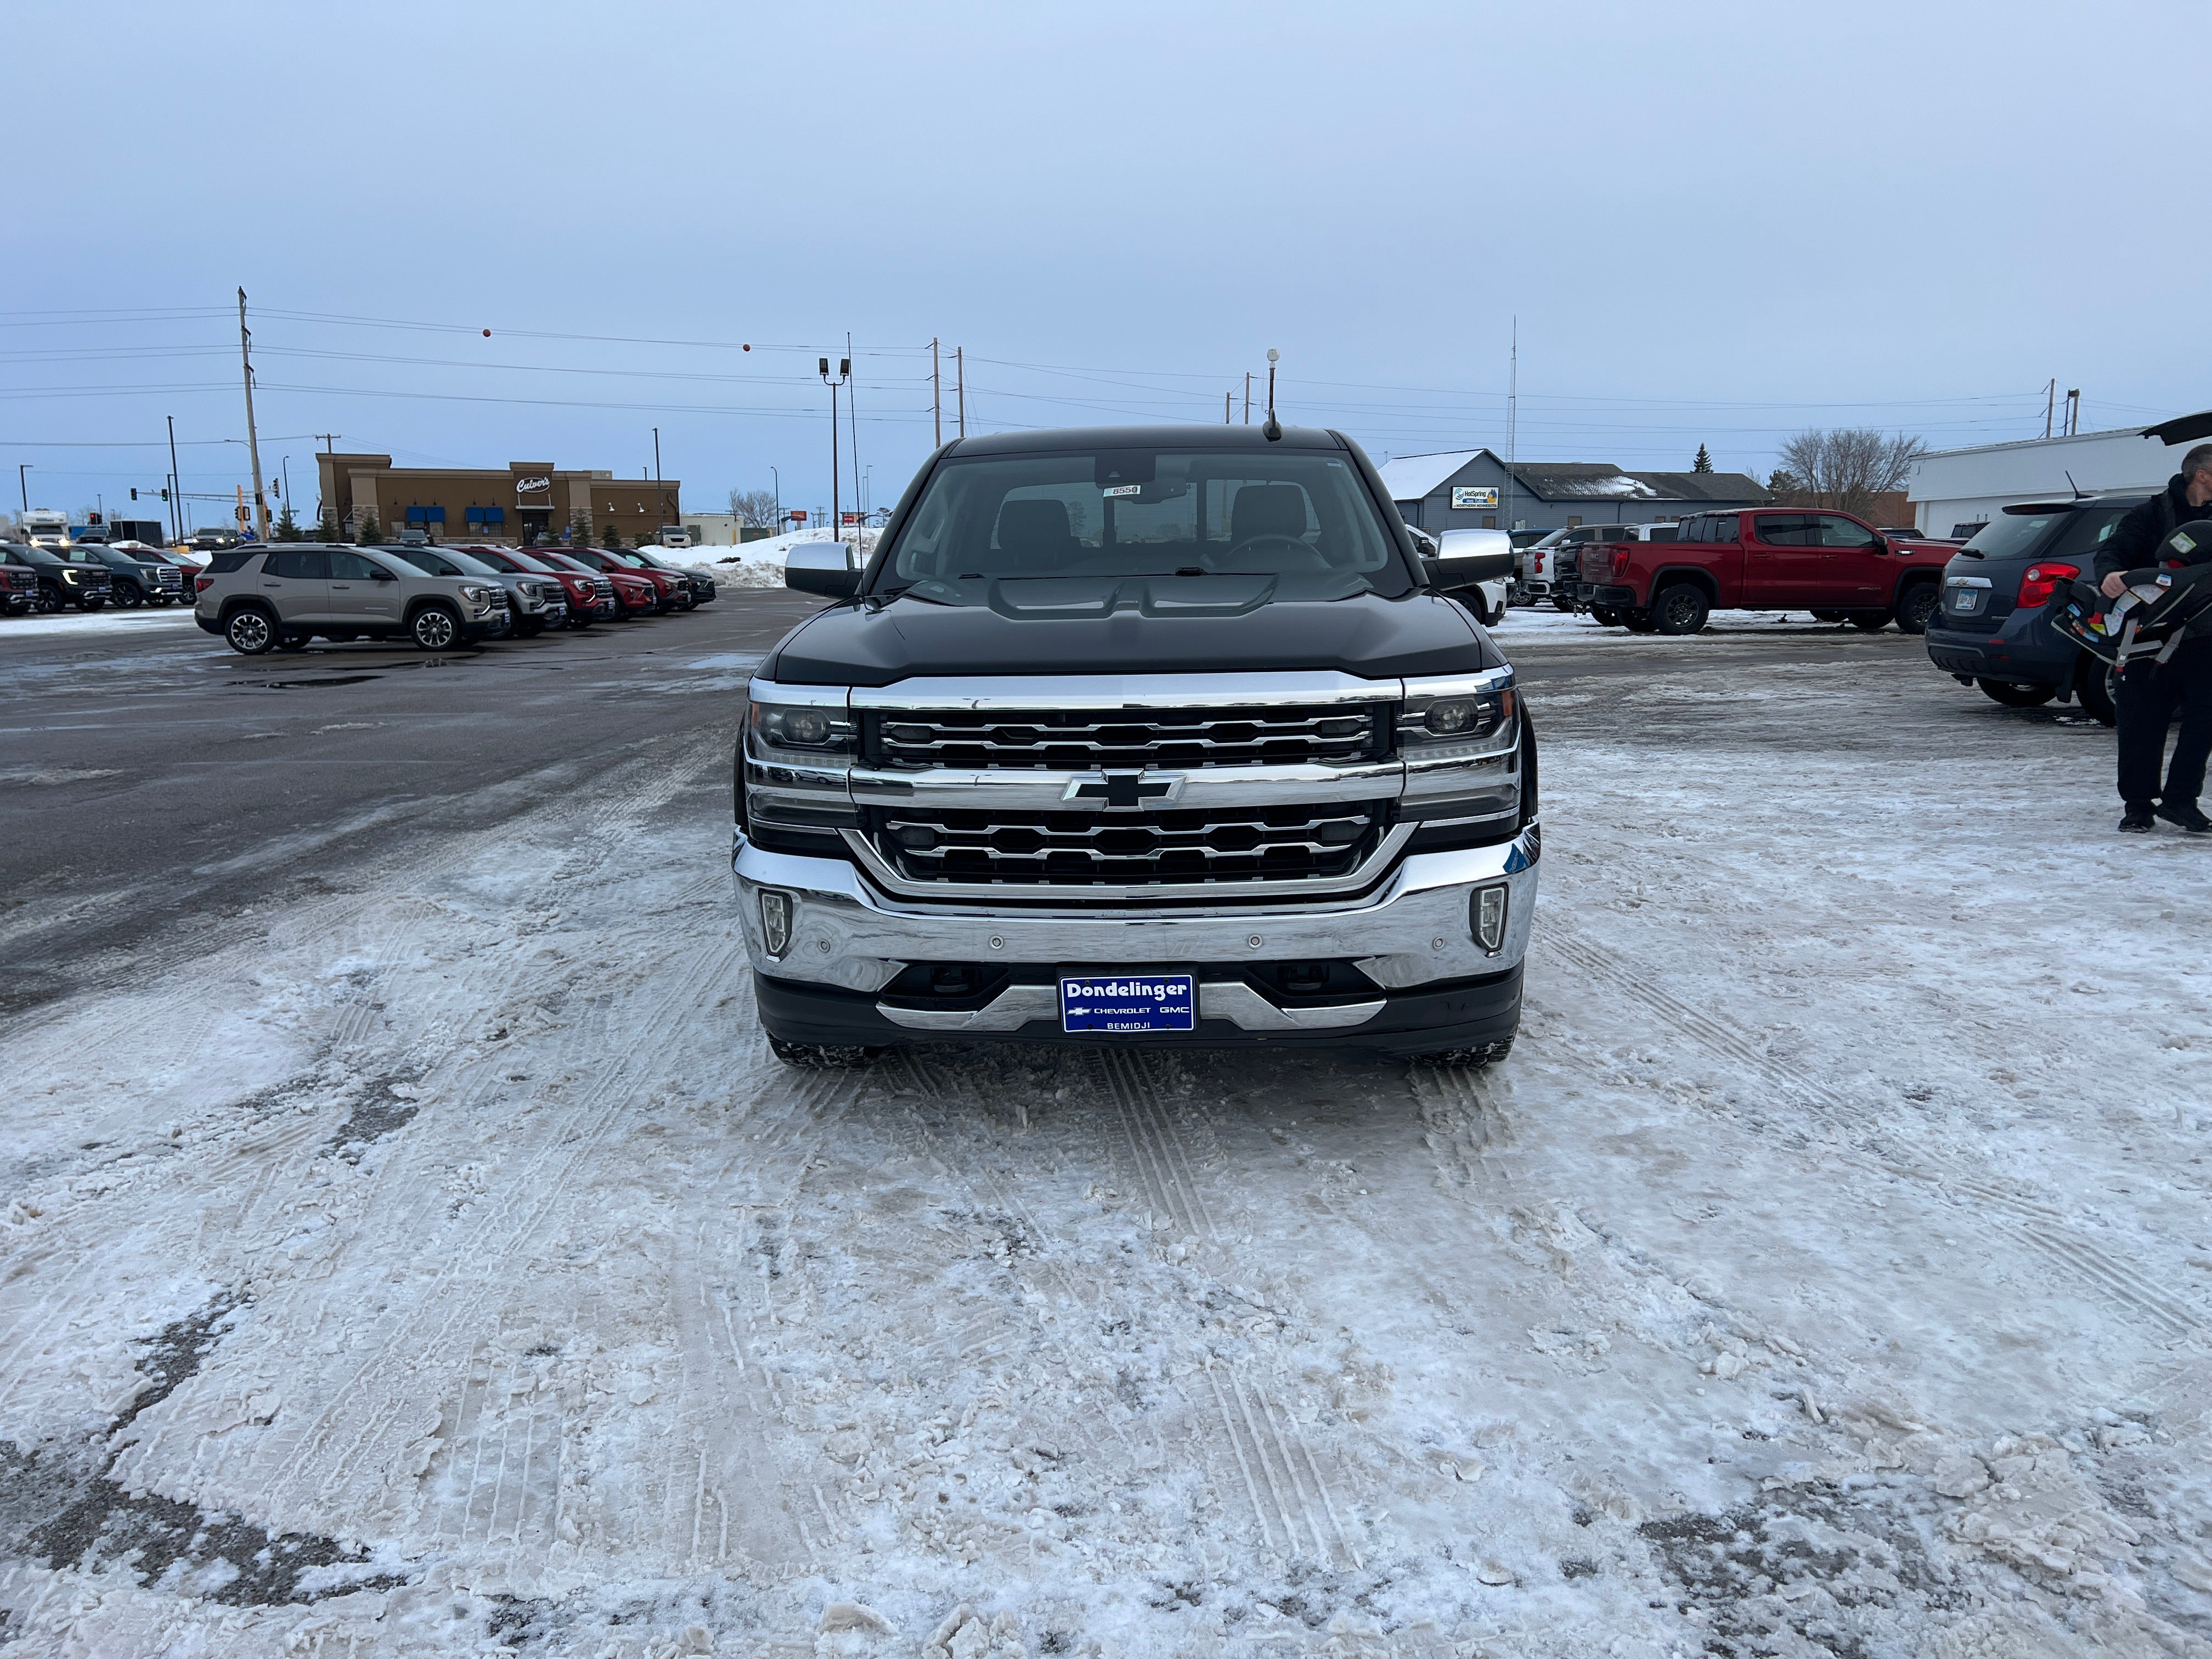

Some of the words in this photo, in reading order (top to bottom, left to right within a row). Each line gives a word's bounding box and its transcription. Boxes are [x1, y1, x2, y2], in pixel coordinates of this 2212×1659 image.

[516, 476, 550, 493] Culver's
[1113, 486, 1138, 494] 8550
[1066, 981, 1187, 1001] Dondelinger
